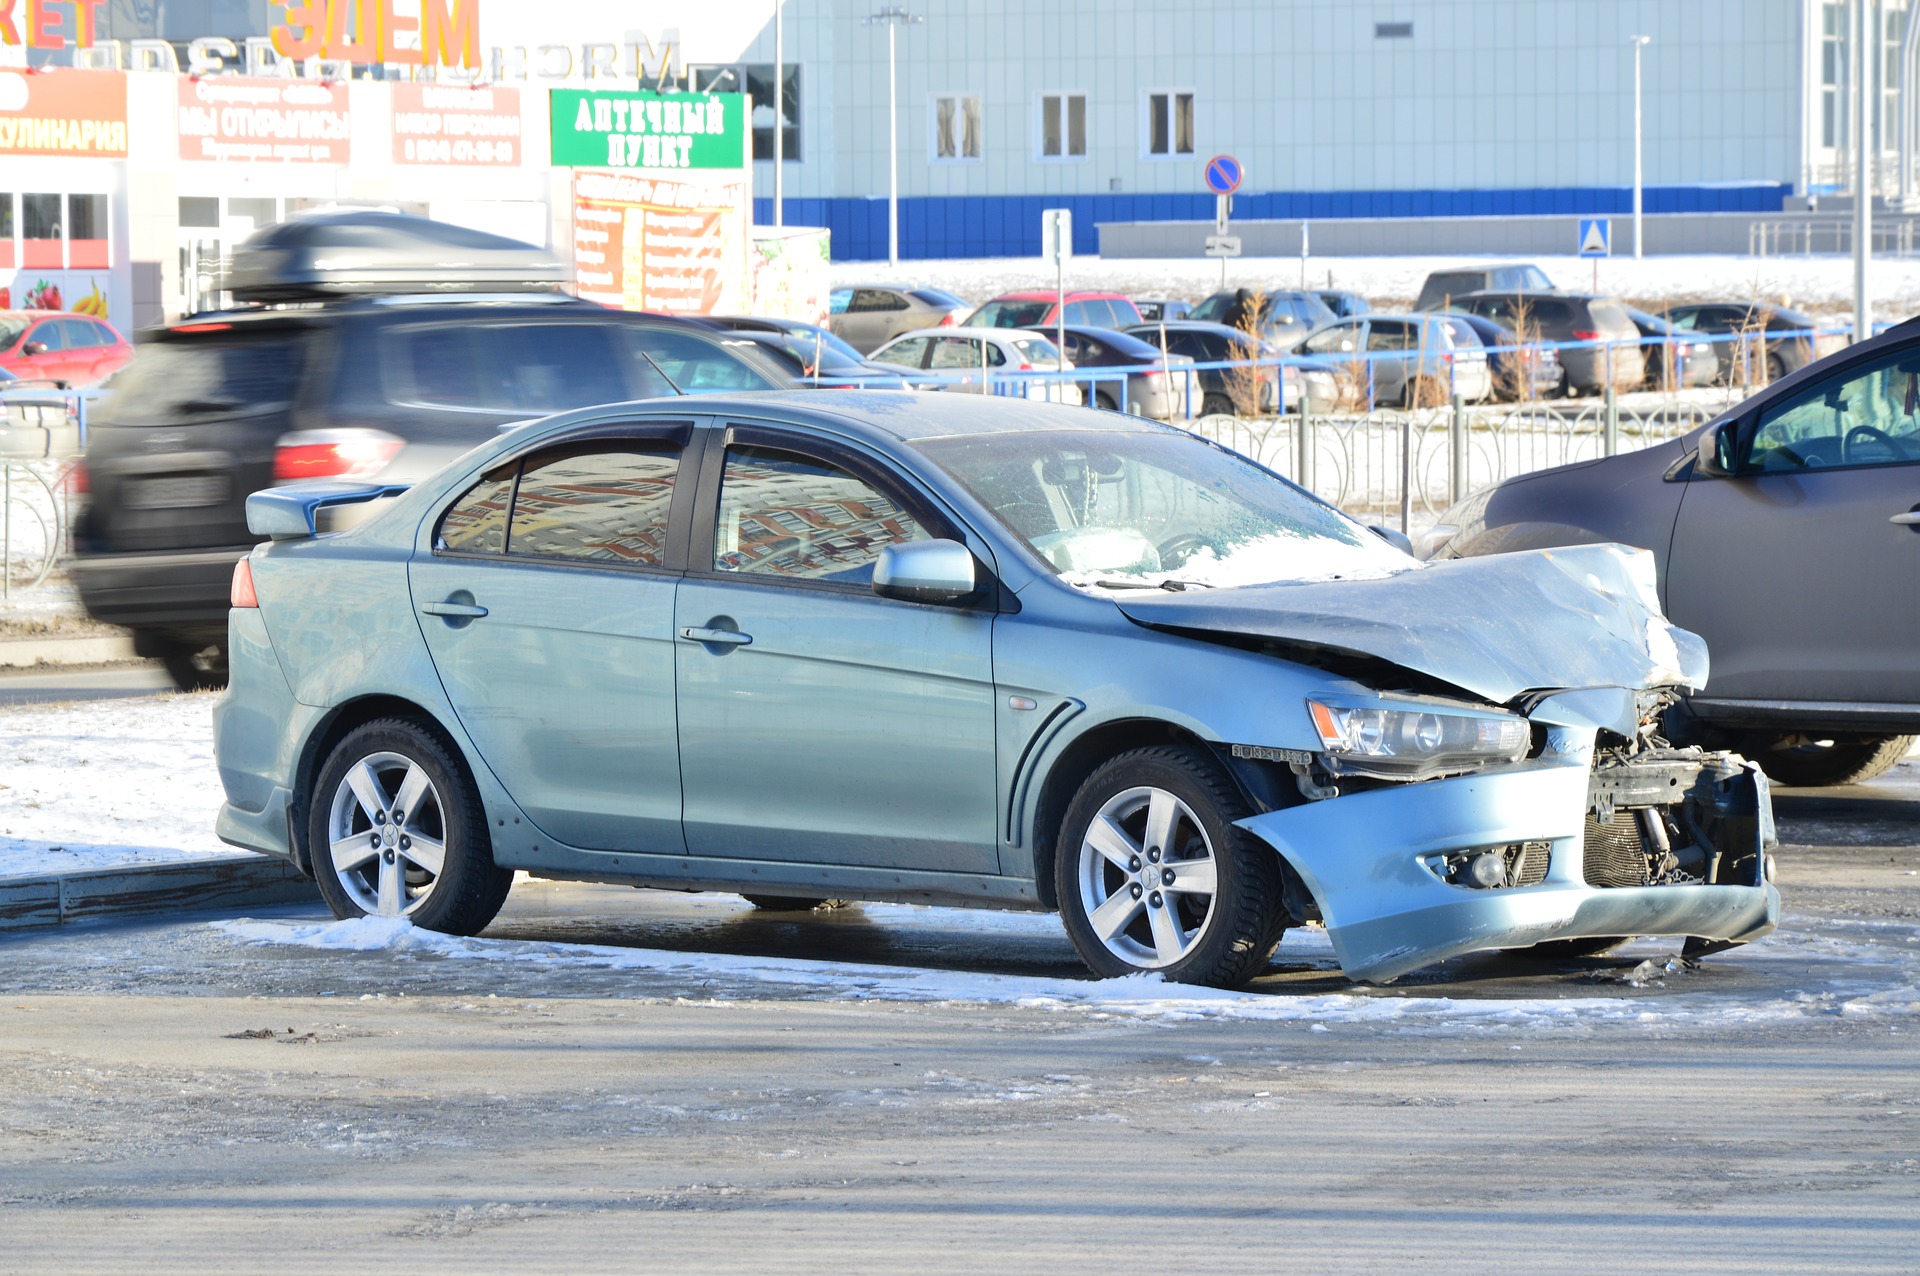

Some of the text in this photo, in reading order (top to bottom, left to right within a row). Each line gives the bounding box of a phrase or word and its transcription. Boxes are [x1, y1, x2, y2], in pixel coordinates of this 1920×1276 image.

[270, 0, 480, 68] ЭДЕМ
[574, 95, 724, 135] АПТЕЧНЫЙ
[0, 117, 126, 151] УЛИНАРИЯ
[607, 133, 693, 168] ПУНКТ
